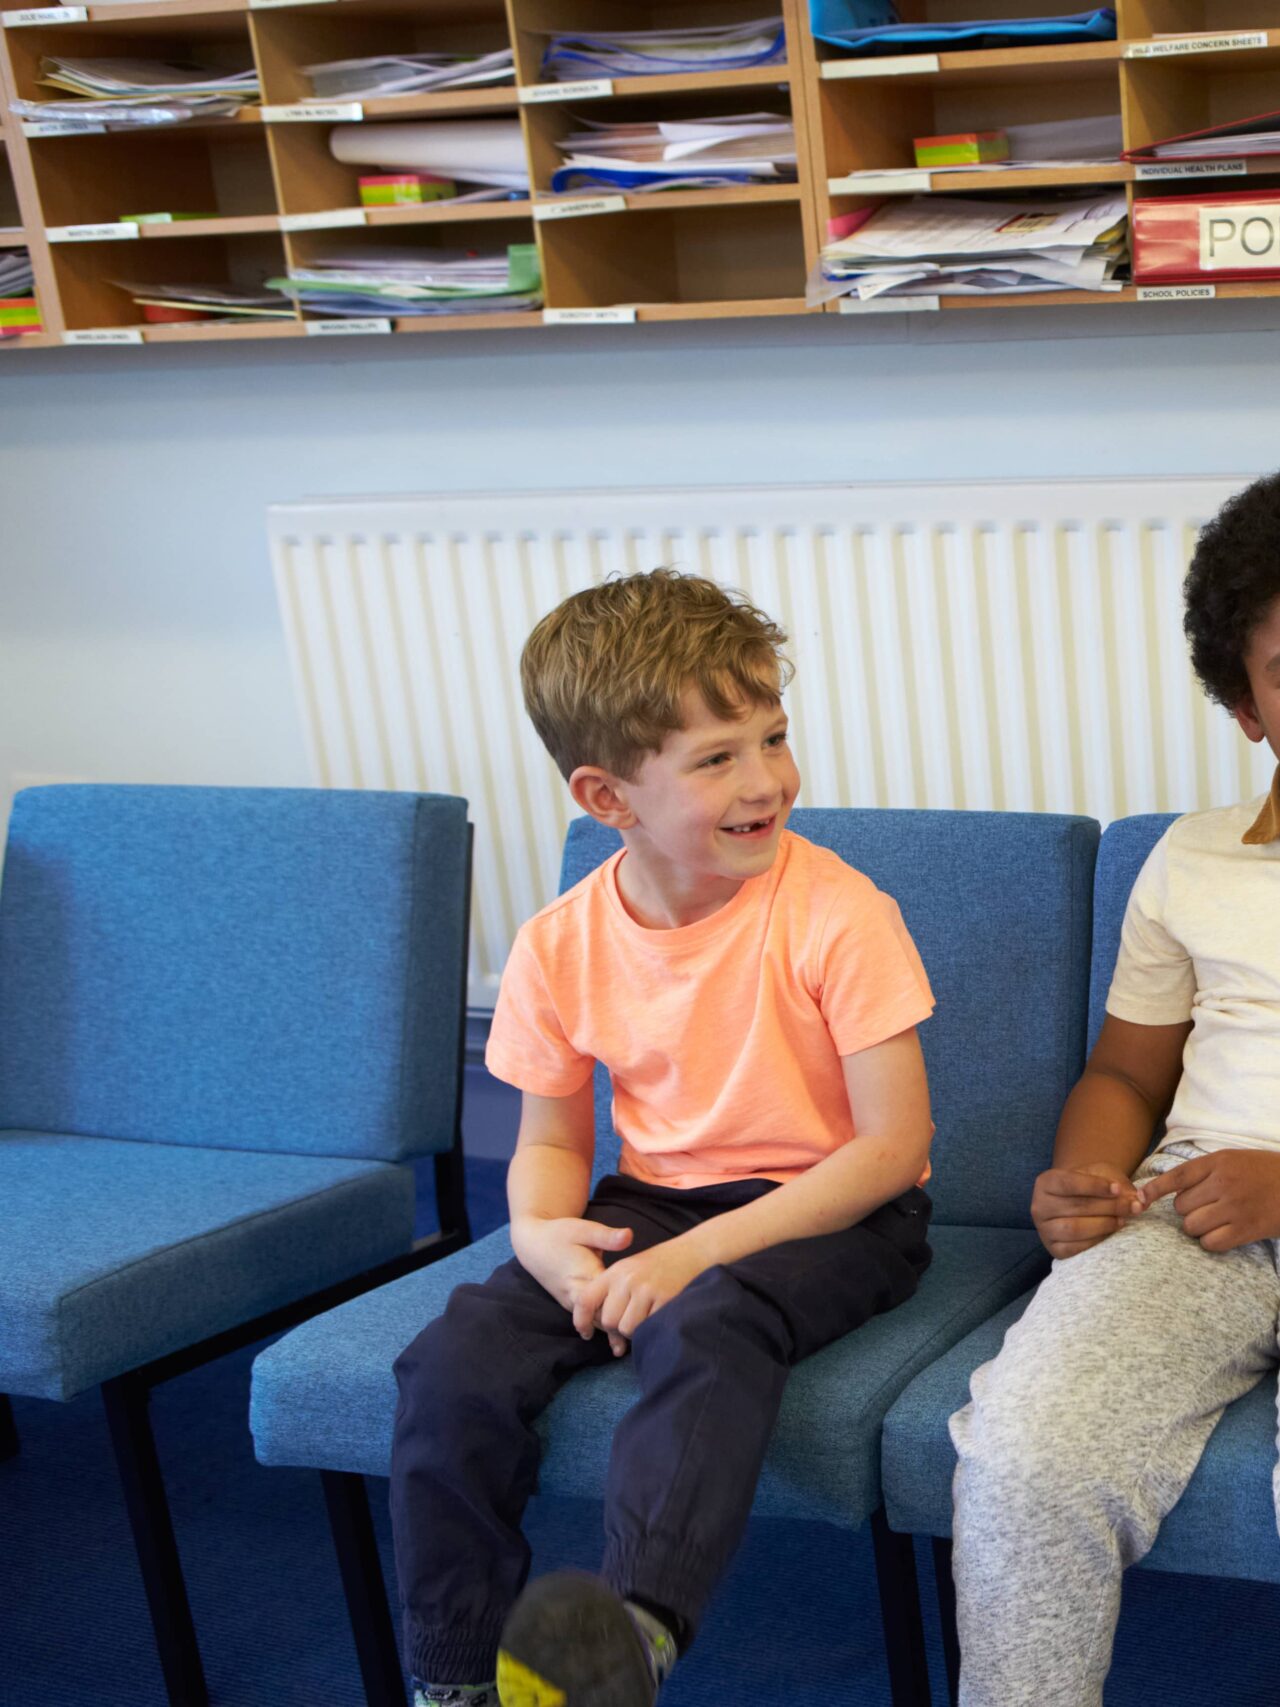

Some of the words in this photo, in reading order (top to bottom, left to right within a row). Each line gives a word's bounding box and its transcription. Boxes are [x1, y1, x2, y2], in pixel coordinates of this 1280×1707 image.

[1153, 43, 1190, 53] WELFARE
[1191, 39, 1230, 49] CONCERN
[1232, 37, 1262, 47] SHEETS
[1141, 167, 1183, 176] INDIVIDUAL
[1185, 164, 1216, 173] HEALTH
[1218, 162, 1243, 171] PLANS
[1142, 290, 1174, 299] SCHOOL
[1175, 288, 1210, 297] POLICIES
